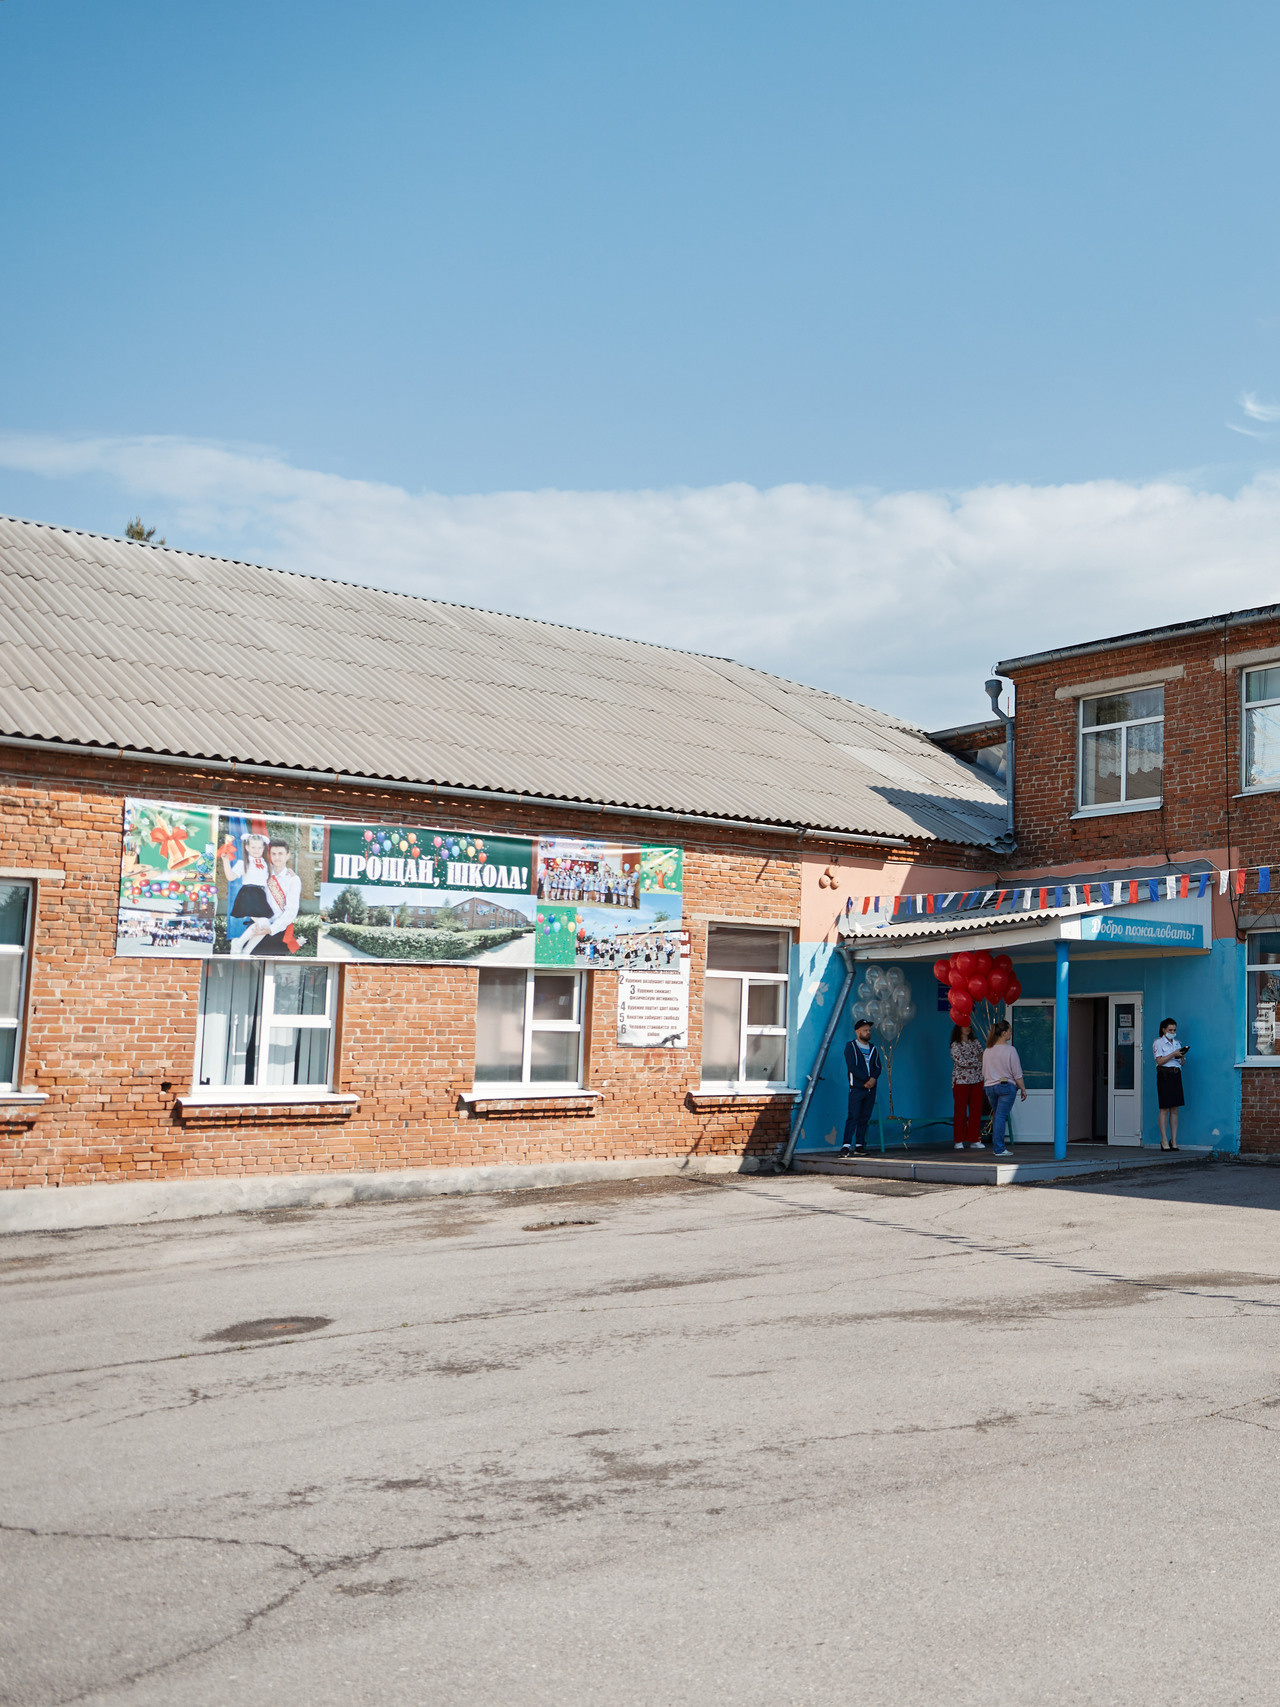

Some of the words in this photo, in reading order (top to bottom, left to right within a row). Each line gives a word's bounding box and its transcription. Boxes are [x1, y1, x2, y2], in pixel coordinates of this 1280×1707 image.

[333, 853, 440, 887] ПРОЩАЙ,
[446, 861, 529, 890] ШКОЛА!
[1091, 918, 1123, 938] Добро
[1125, 924, 1195, 940] пожаловать!
[619, 975, 624, 984] 2
[630, 985, 635, 994] 3
[620, 1001, 626, 1011] 4
[619, 1013, 625, 1022] 5
[620, 1024, 626, 1034] 6
